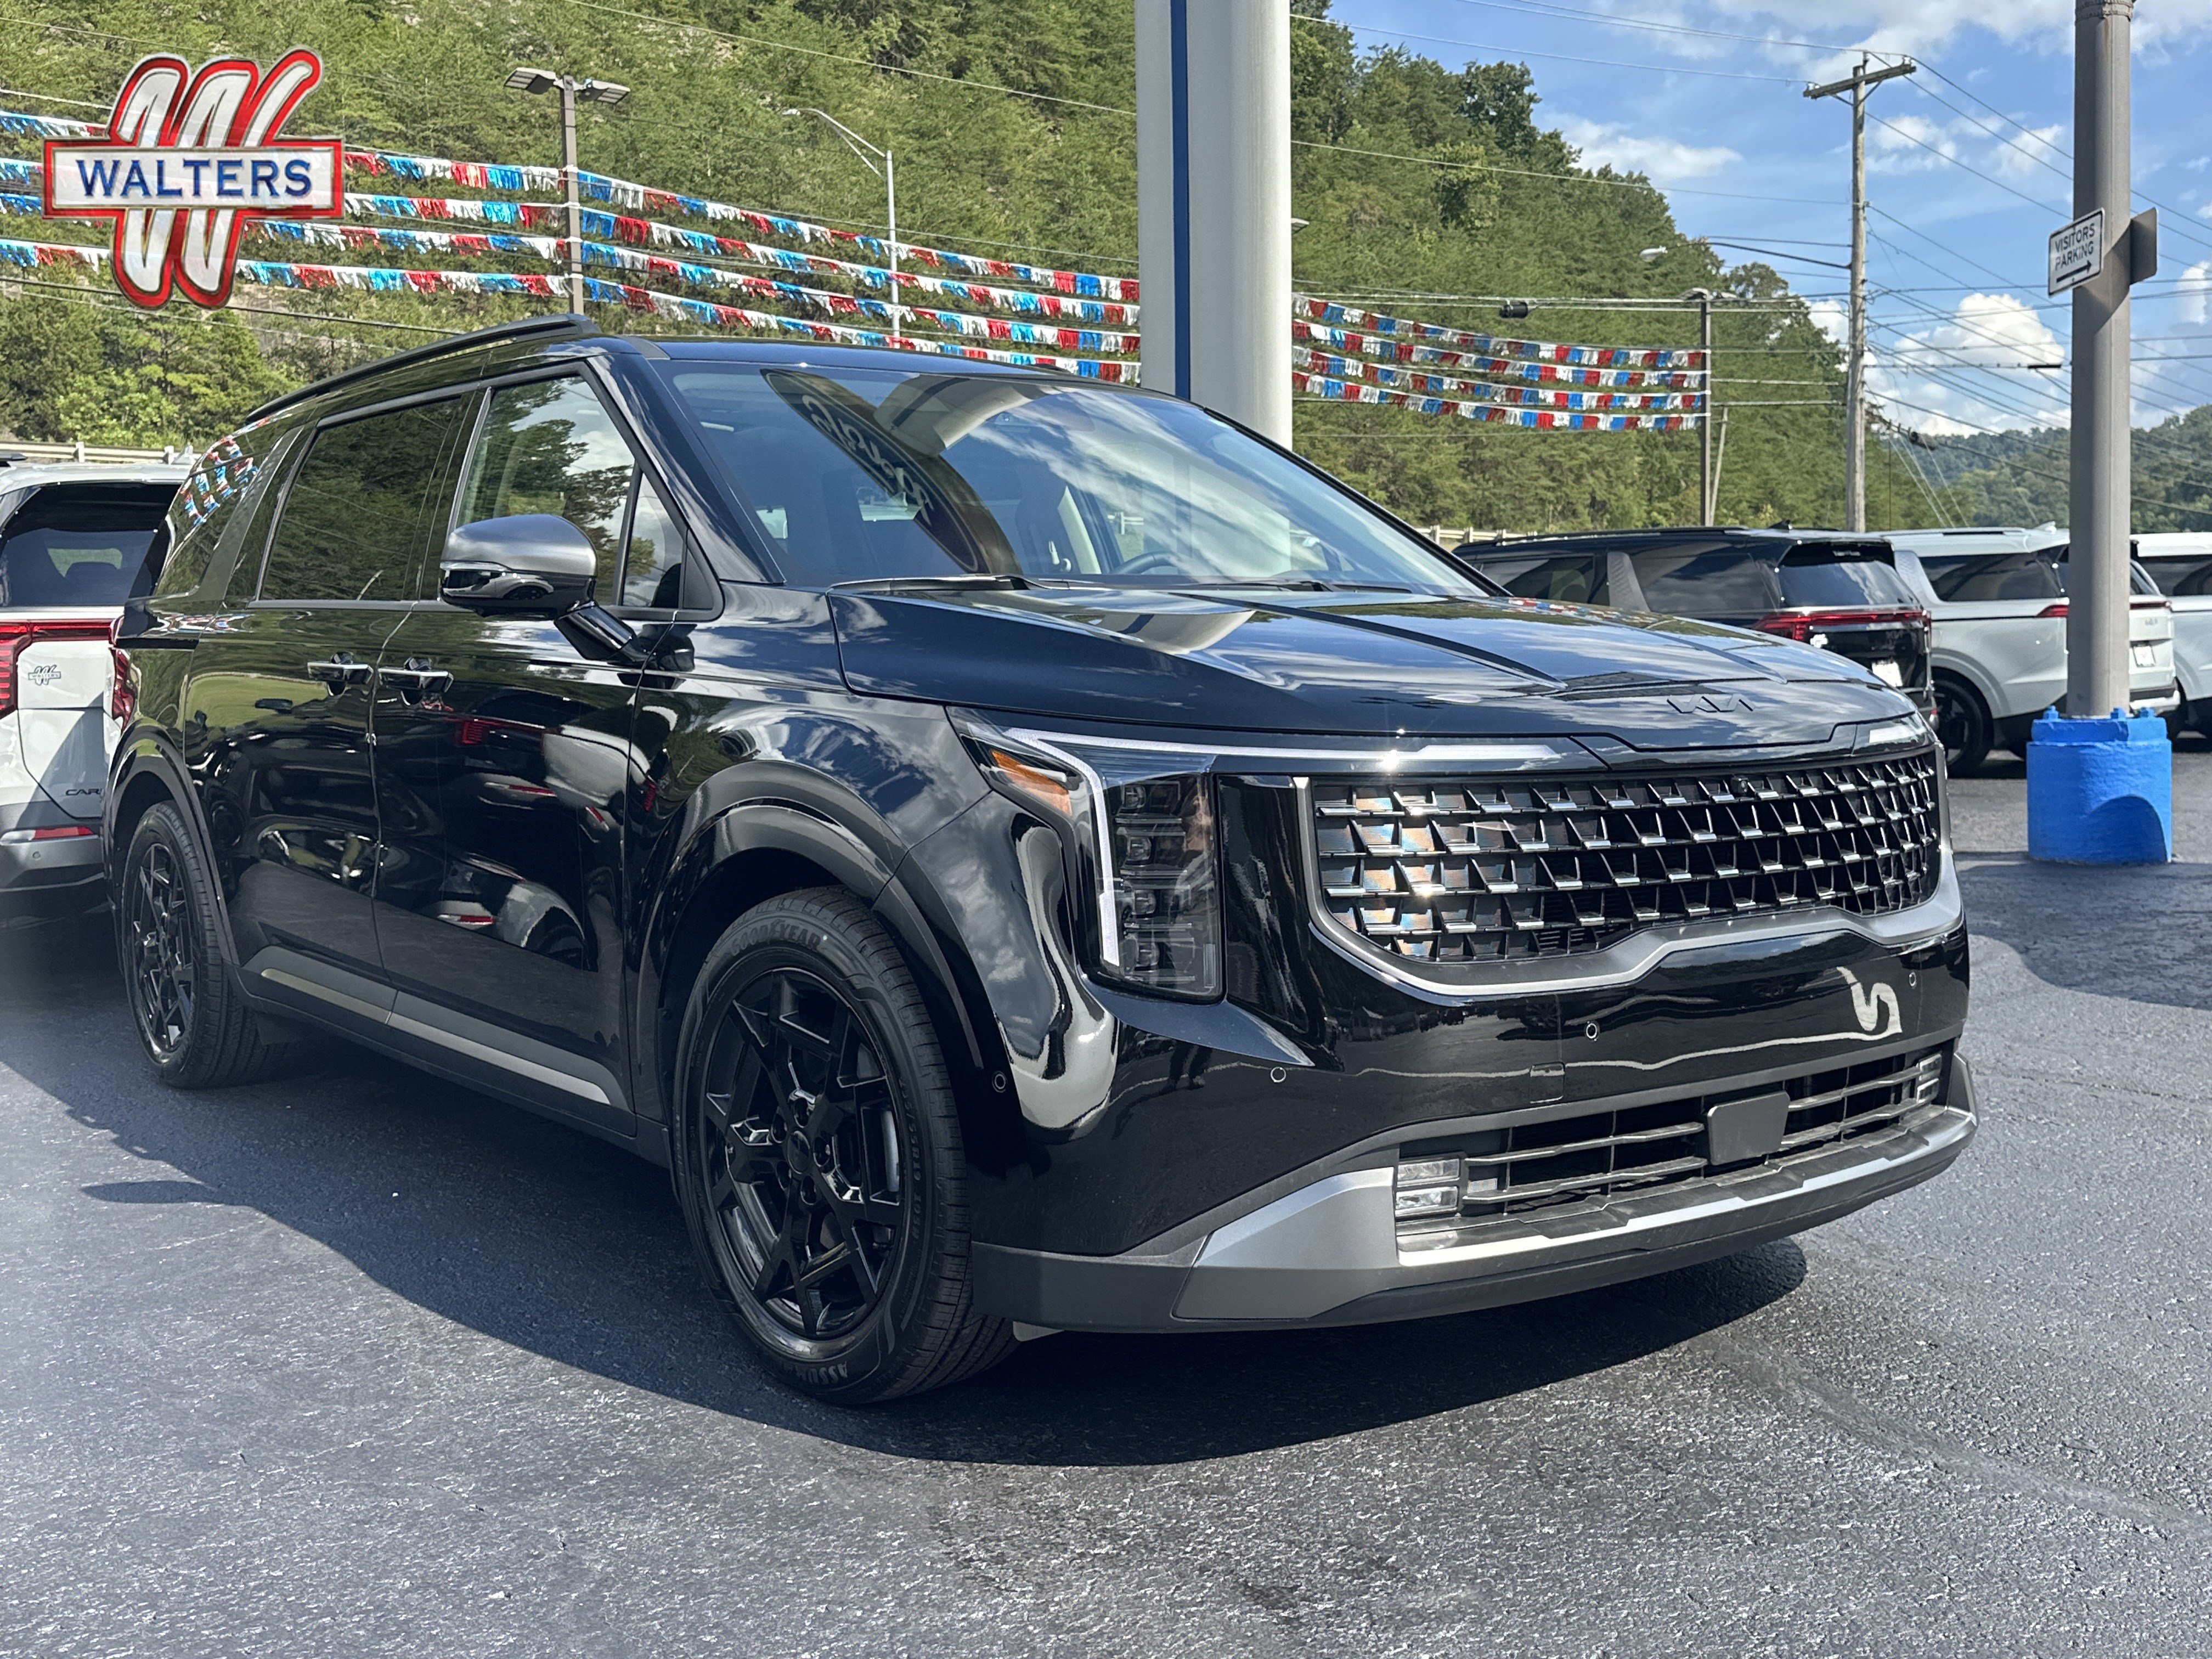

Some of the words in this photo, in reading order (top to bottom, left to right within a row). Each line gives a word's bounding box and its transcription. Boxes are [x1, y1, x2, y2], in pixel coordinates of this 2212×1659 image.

[2055, 223, 2095, 253] VISITORS
[2055, 240, 2094, 271] PARKING
[730, 919, 821, 957] GOODYEAR
